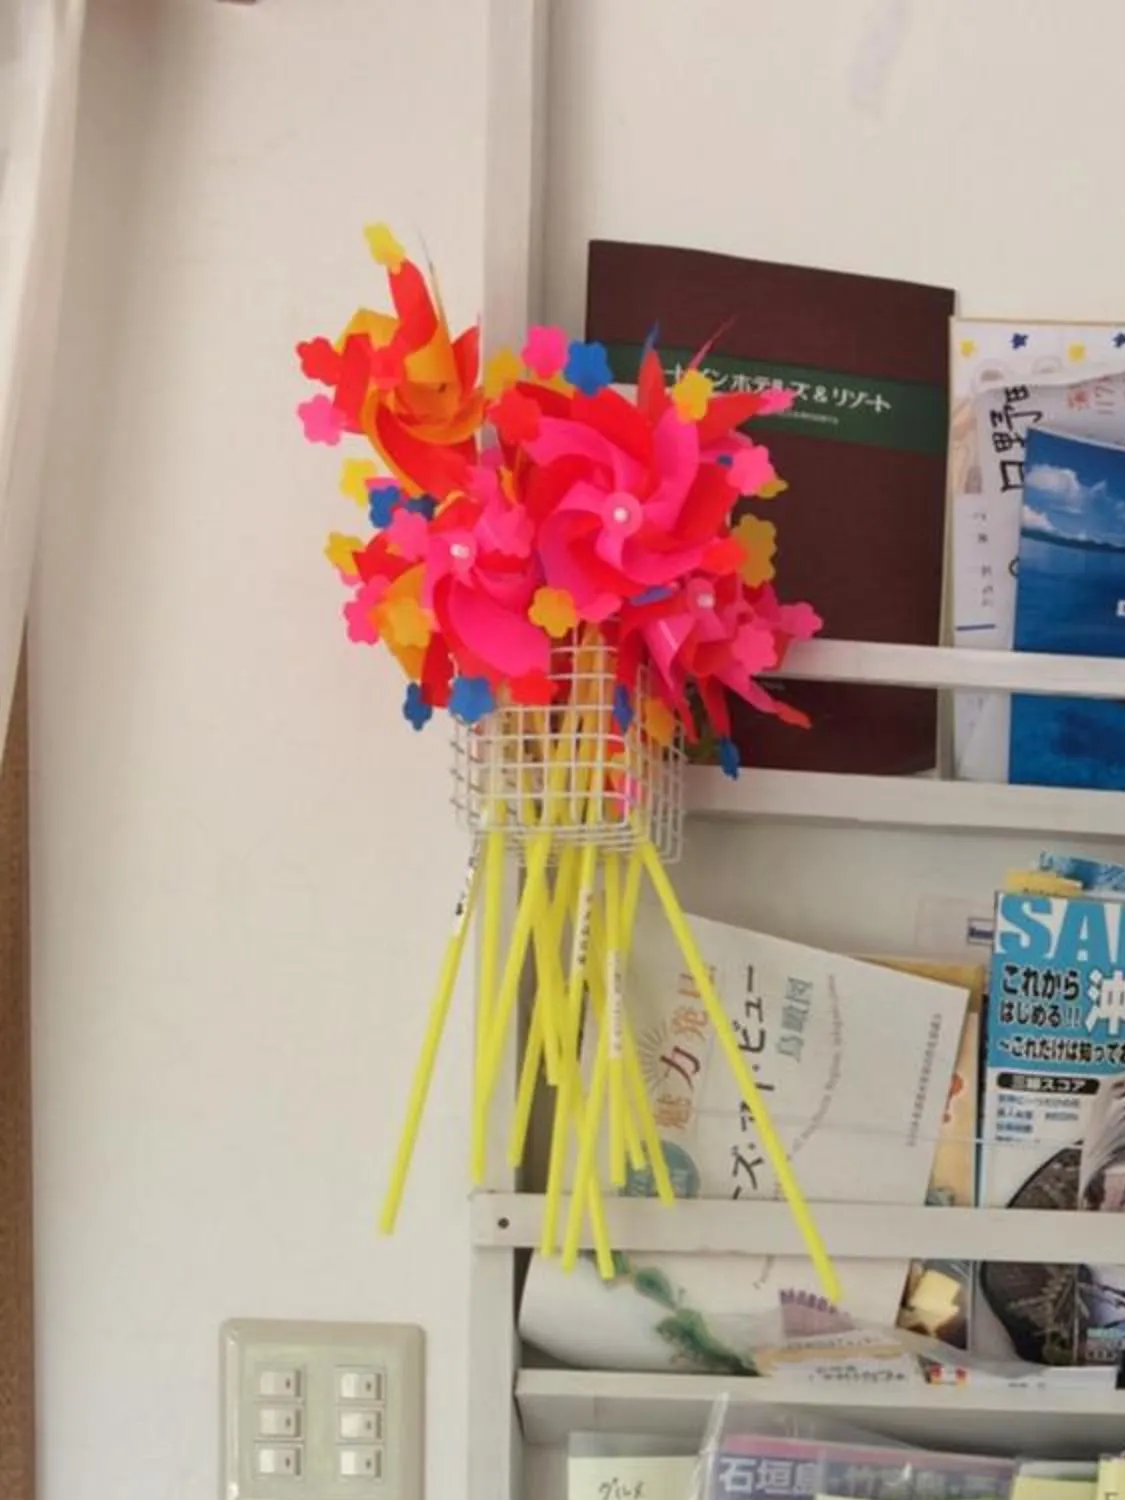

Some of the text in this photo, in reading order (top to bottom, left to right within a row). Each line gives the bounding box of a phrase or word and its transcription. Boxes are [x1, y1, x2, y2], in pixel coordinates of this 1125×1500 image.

[1002, 964, 1081, 1000] これから
[599, 1476, 646, 1500] グルメ
